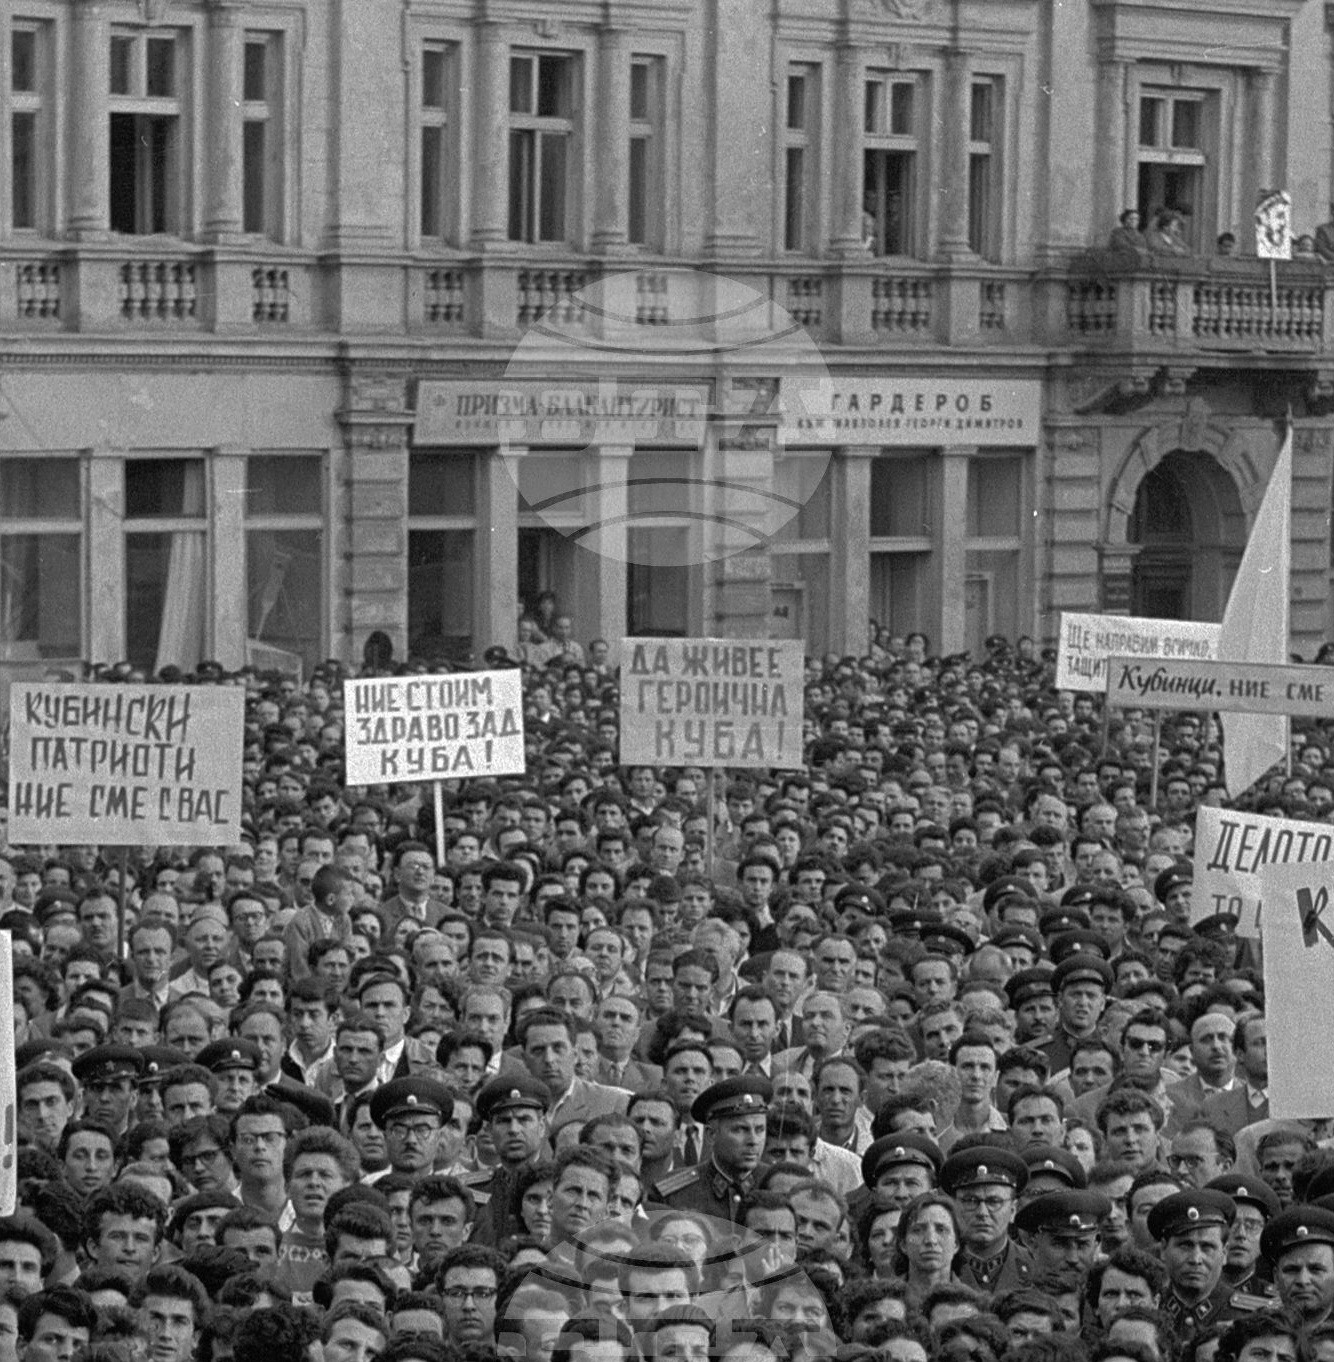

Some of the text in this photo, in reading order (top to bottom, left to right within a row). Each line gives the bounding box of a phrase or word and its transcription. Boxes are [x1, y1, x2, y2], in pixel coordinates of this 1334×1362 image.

[832, 393, 993, 415] ГАРДЕРОБ
[629, 644, 783, 678] ДА ЖИВЕЕ
[355, 676, 494, 714] НИЕ СТОИМ
[638, 679, 789, 718] ГЕРОИЧНА
[1229, 678, 1271, 699] НИЕ
[1286, 682, 1324, 702] СМЕ
[25, 691, 191, 743] КУБИНСКИ
[356, 708, 521, 746] ЗДРАВО ЗАД
[30, 736, 196, 782] ПАТРИОТИ
[15, 782, 73, 818] НИЕ
[89, 784, 149, 821] СМЕ
[177, 786, 230, 825] ВАС
